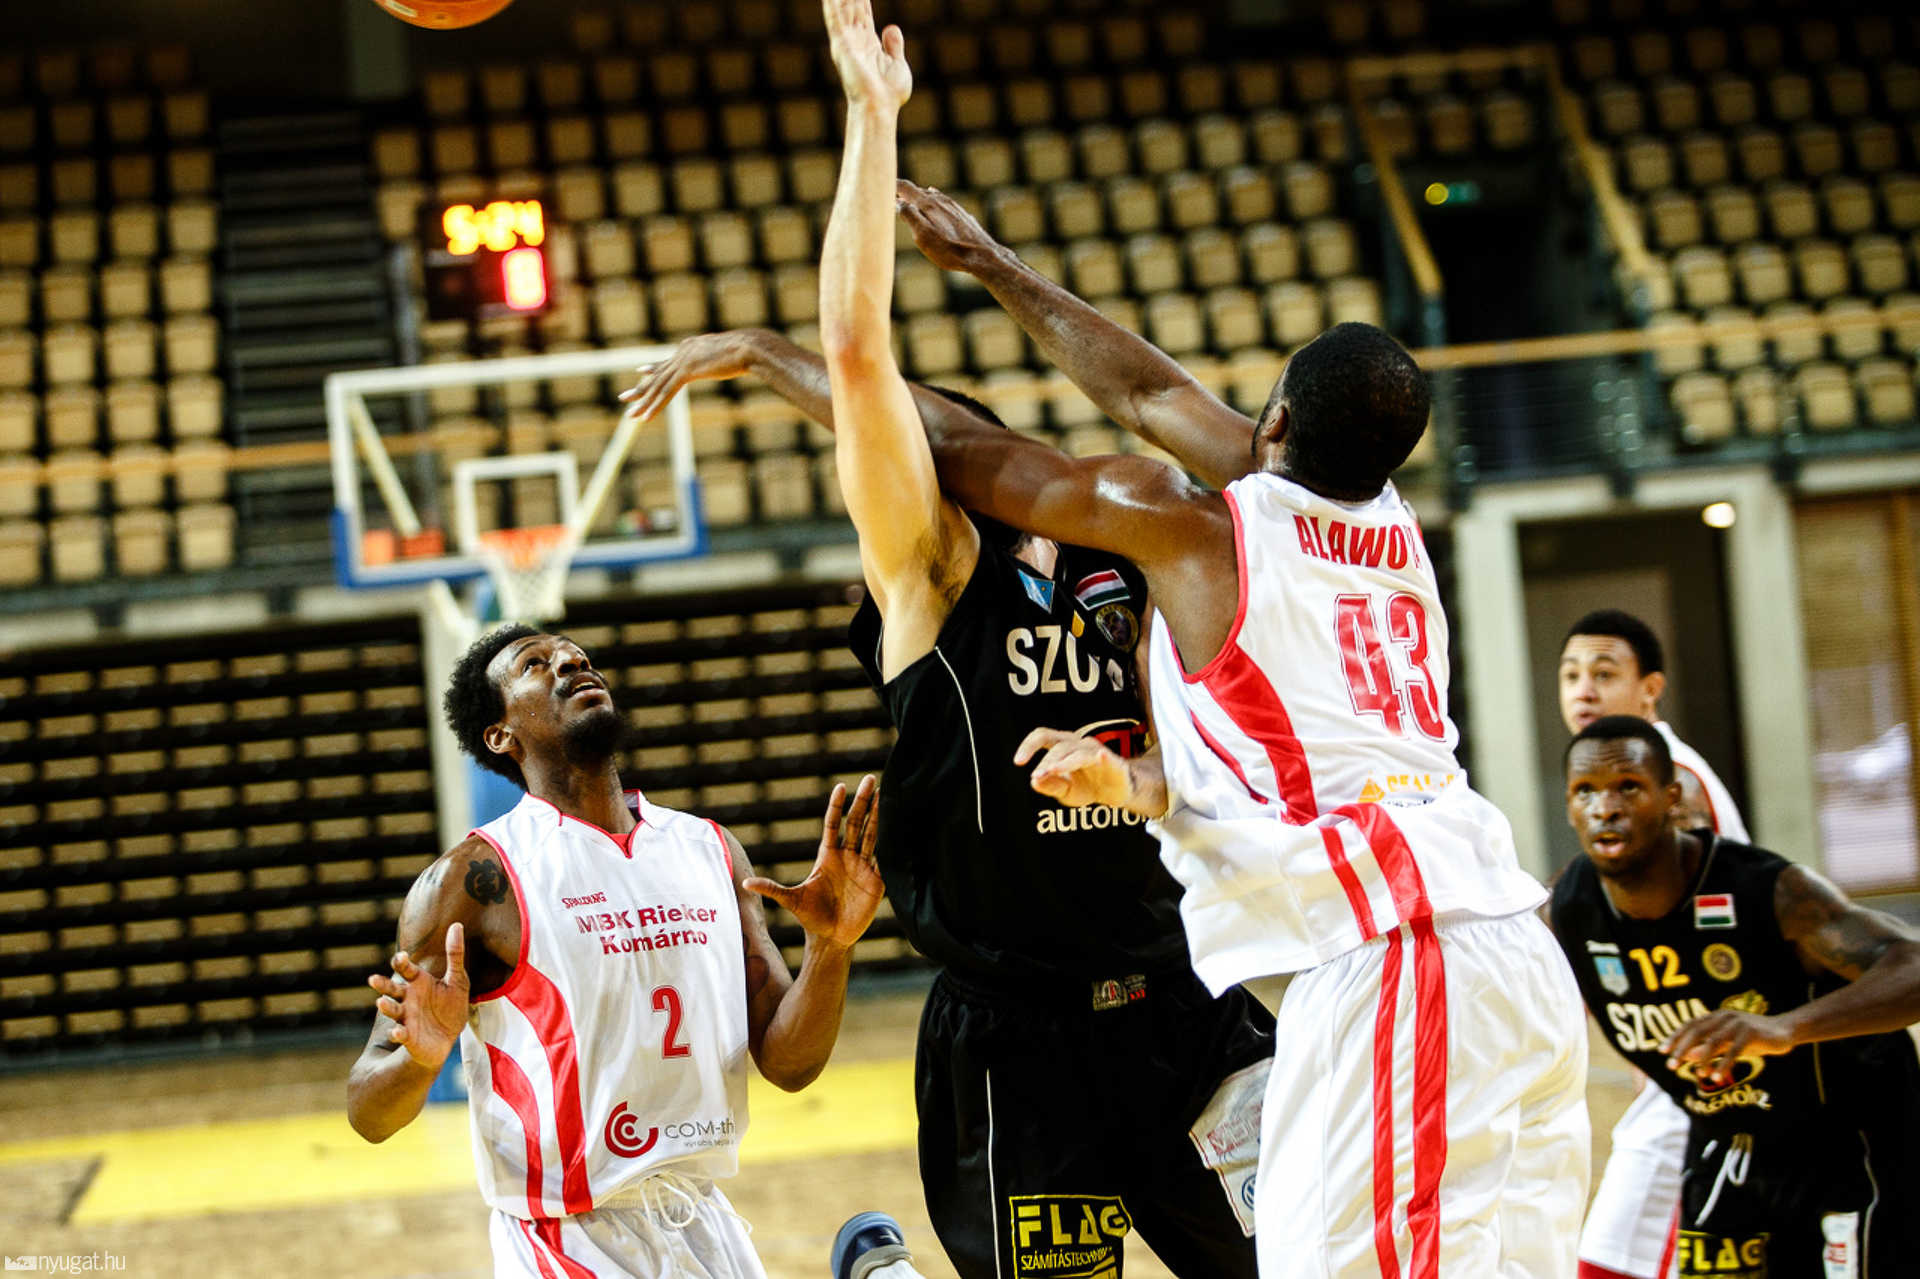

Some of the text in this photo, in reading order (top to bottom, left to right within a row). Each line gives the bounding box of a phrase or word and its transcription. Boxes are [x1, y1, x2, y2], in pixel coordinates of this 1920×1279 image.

[1333, 591, 1446, 743] 43
[1036, 804, 1147, 834] autofo
[575, 903, 718, 935] MBK Rieker
[600, 928, 708, 955] Komárno
[1628, 945, 1691, 992] 12
[651, 985, 692, 1060] 2
[1017, 1204, 1127, 1248] FLAG
[1678, 1237, 1762, 1271] FLAG
